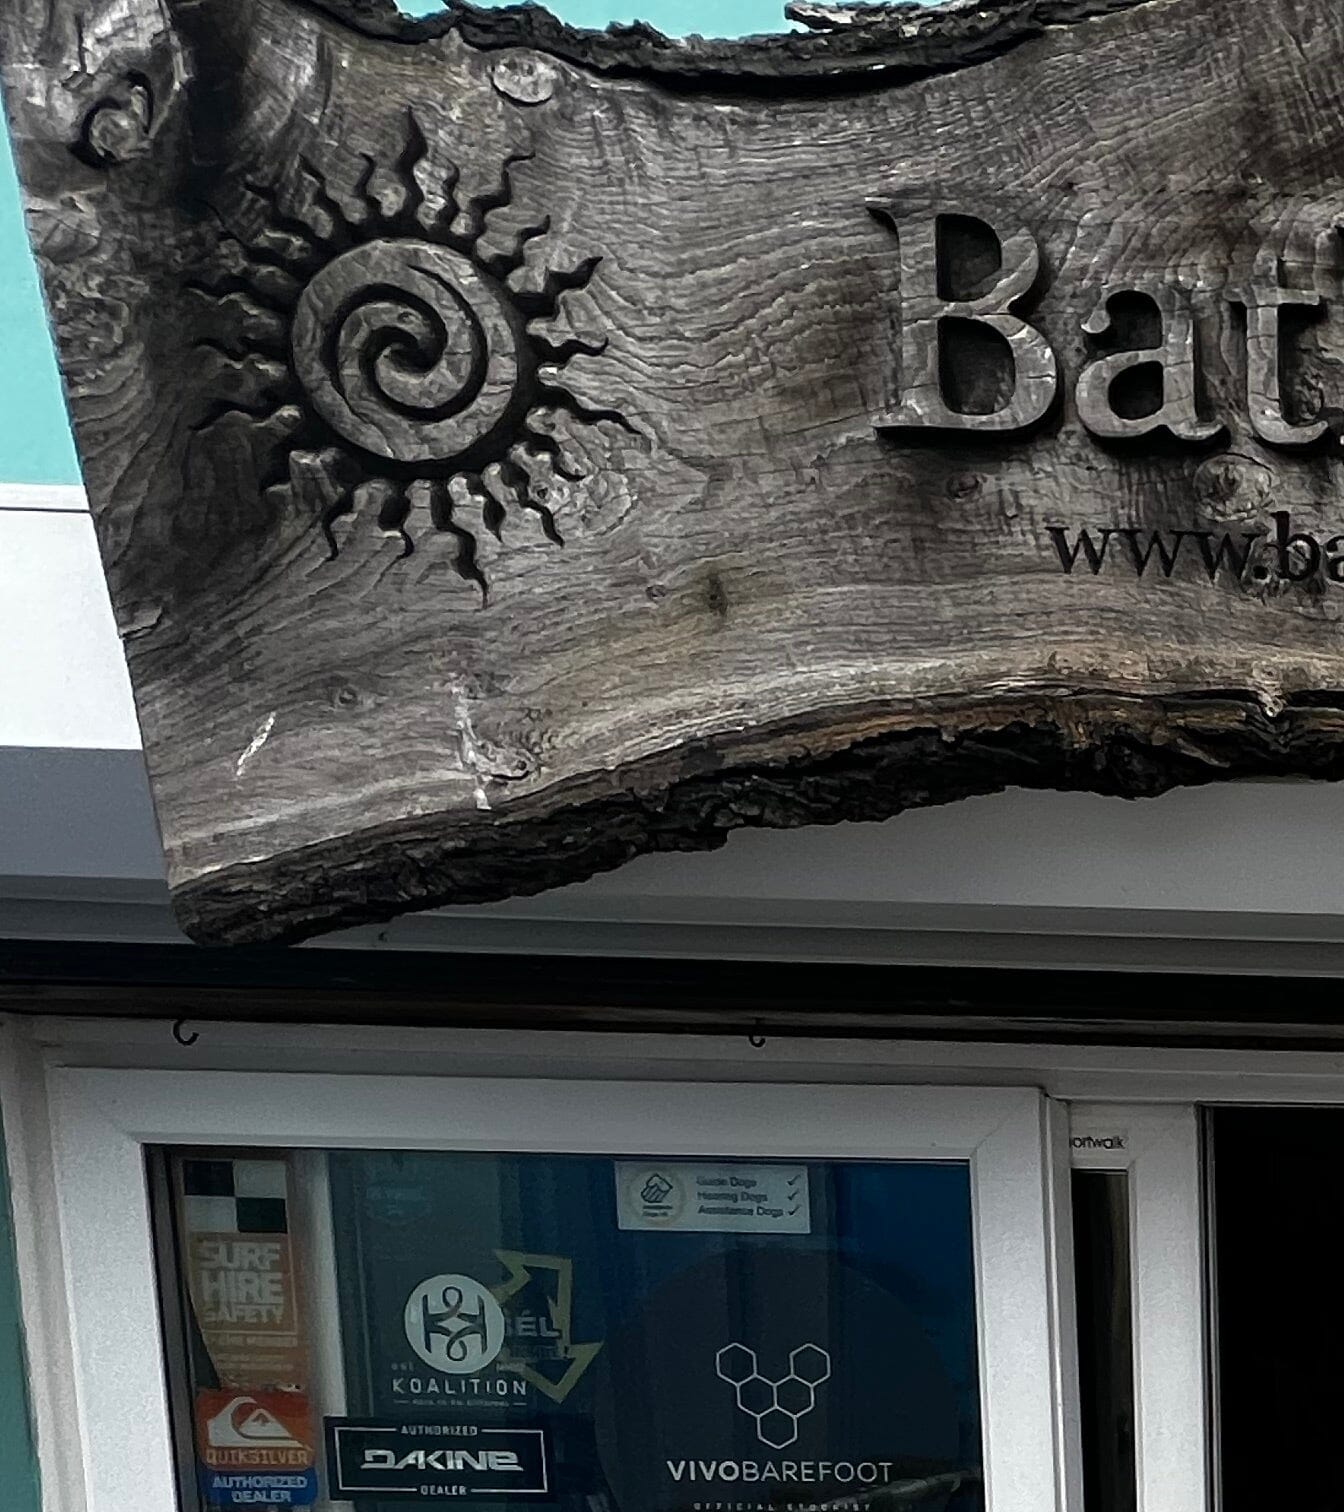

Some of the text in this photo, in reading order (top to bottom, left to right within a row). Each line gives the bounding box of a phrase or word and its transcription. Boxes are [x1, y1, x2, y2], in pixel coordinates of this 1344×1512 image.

[204, 1240, 281, 1270] SURF
[202, 1270, 284, 1301] HIRE
[203, 1303, 284, 1323] SAFETY
[392, 1378, 527, 1396] KOALITION
[400, 1425, 478, 1436] AUTHORIZED
[206, 1449, 309, 1466] QUIKSILVER
[666, 1460, 894, 1483] VIVOBAREFOOT
[212, 1475, 309, 1489] AUTHORIZED
[420, 1485, 468, 1496] DEALER
[231, 1489, 291, 1503] DEALER
